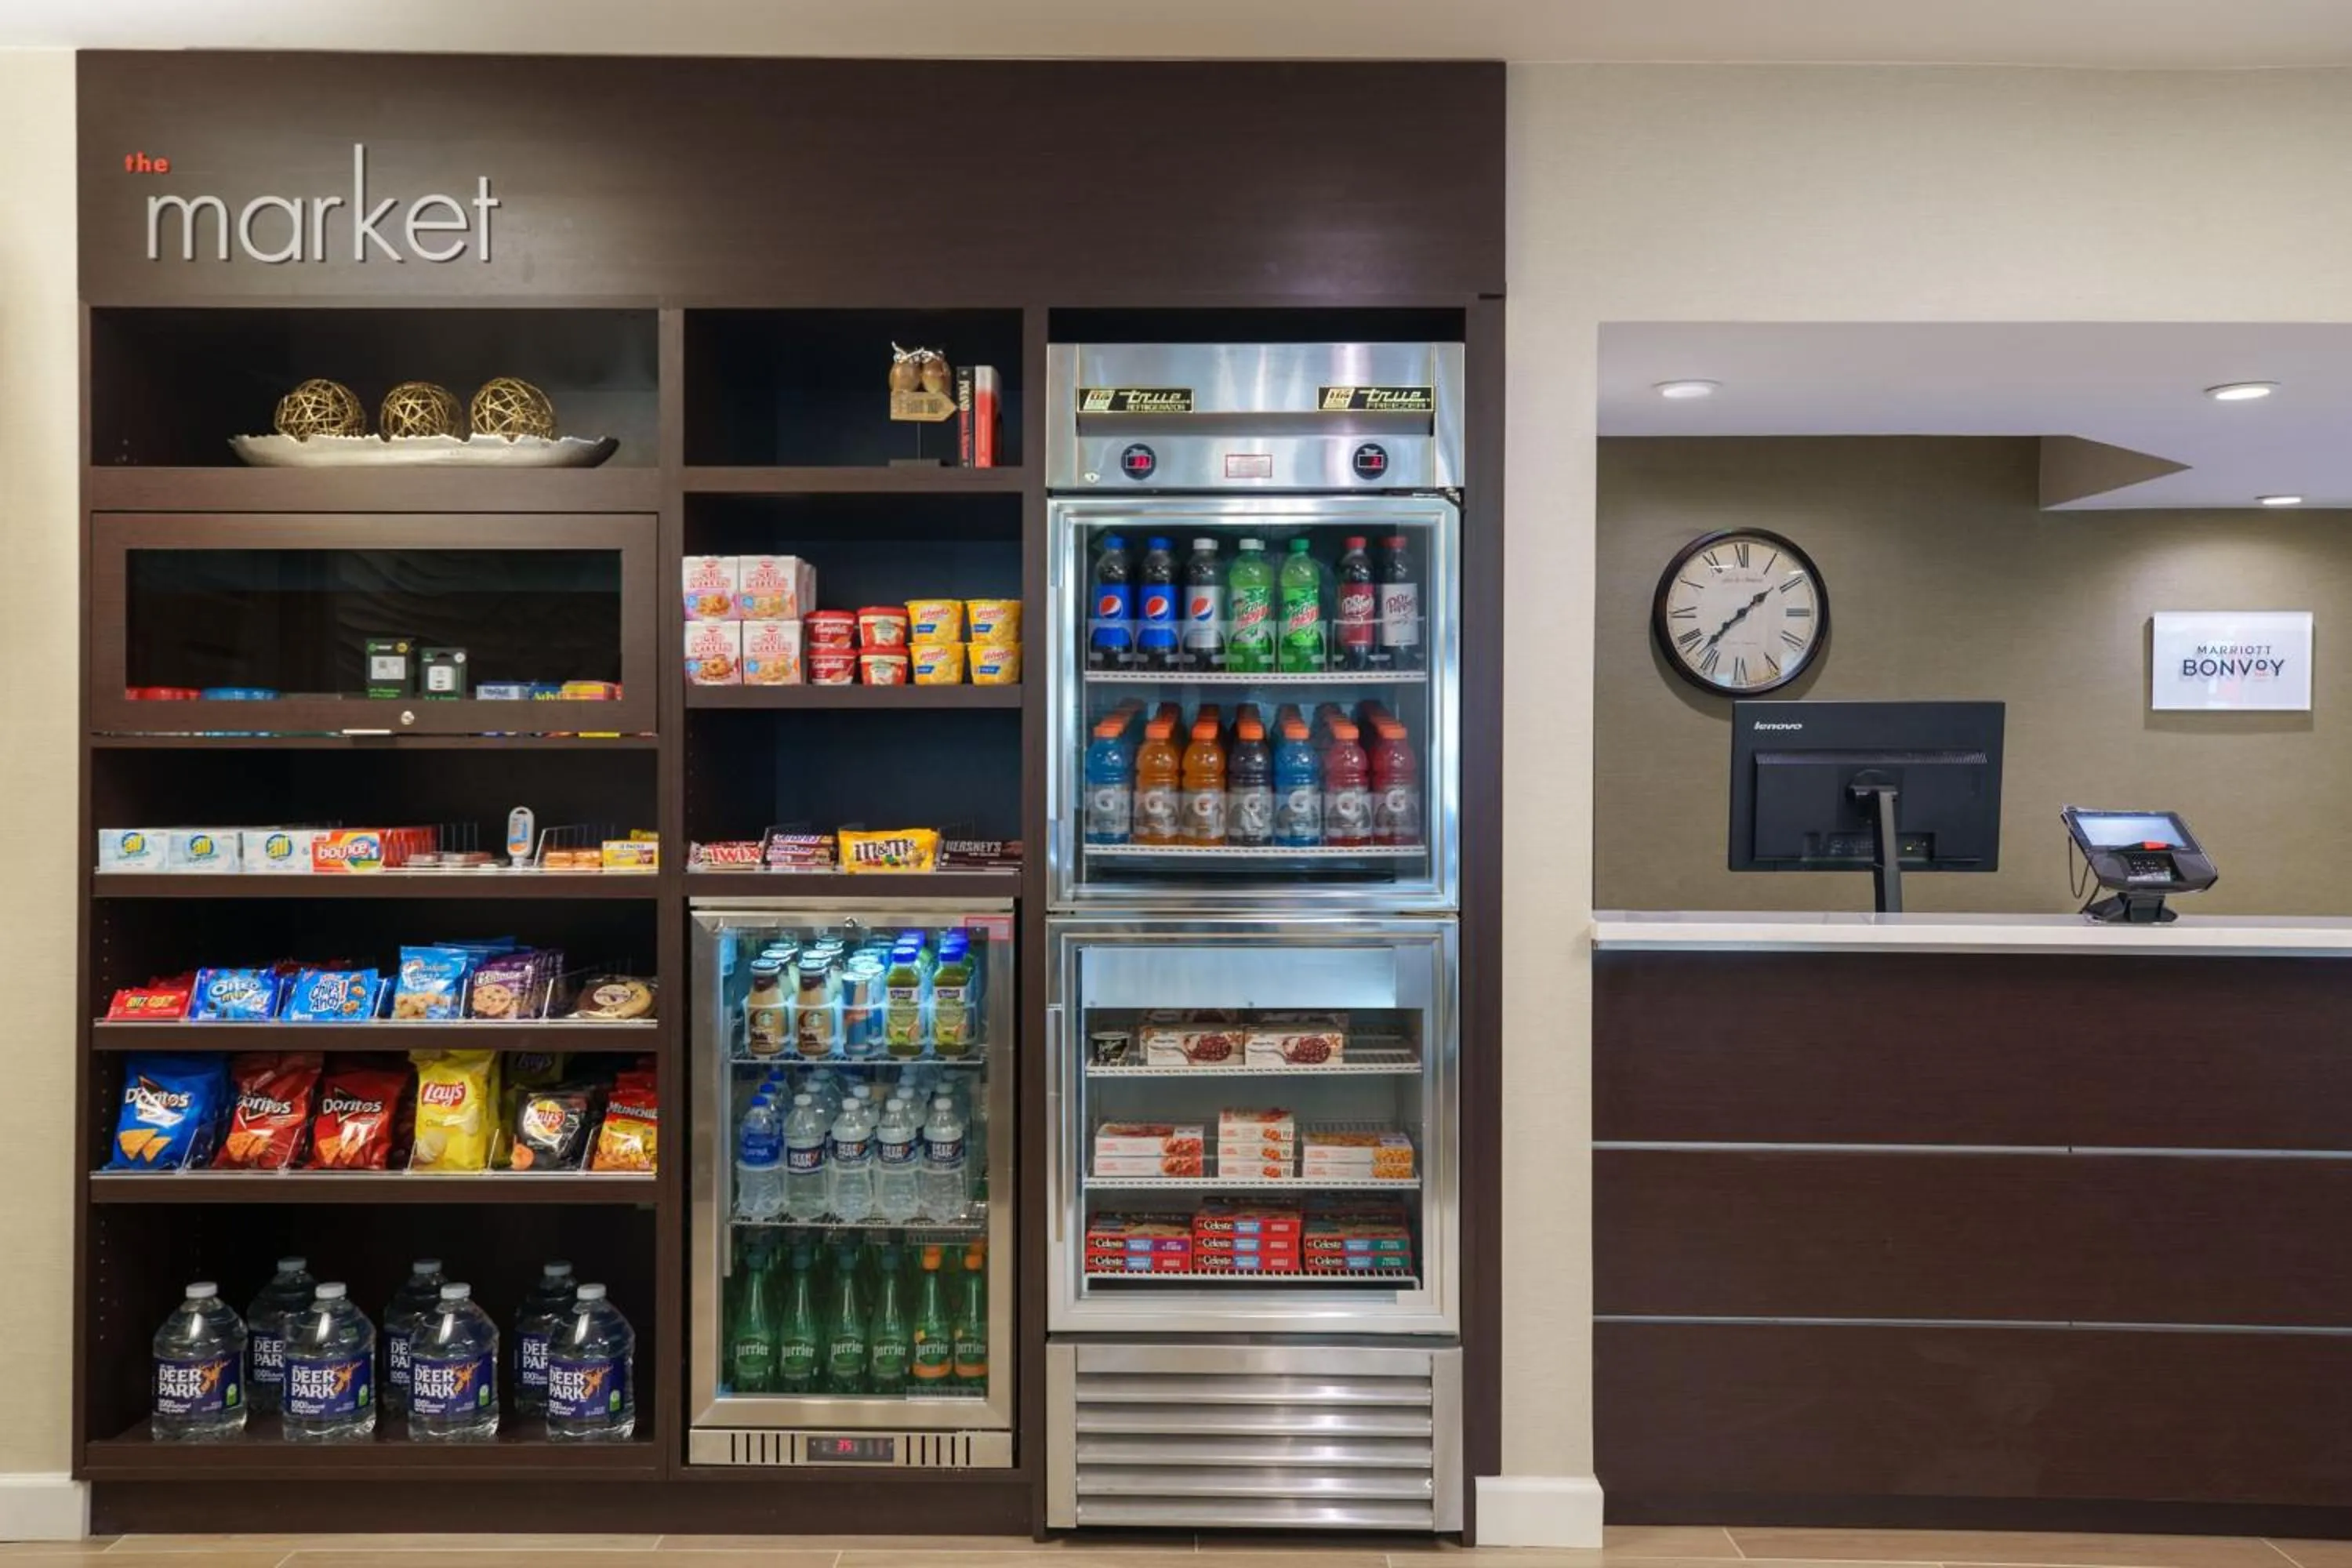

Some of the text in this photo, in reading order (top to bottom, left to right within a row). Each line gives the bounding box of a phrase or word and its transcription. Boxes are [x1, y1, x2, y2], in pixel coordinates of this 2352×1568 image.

[125, 152, 169, 173] the
[147, 143, 501, 263] market
[2197, 645, 2271, 655] MARRIOTT
[1754, 721, 1802, 730] lenovo
[1097, 789, 1116, 811] G
[1145, 792, 1164, 815] G
[1194, 793, 1214, 816] G
[1243, 793, 1261, 813] G
[1289, 789, 1310, 814] G
[1337, 791, 1362, 818] G
[1386, 789, 1406, 812] G
[193, 837, 212, 854] all
[322, 1098, 383, 1114] Doritos
[253, 1340, 285, 1352] DEE
[390, 1341, 411, 1355] DE
[523, 1341, 548, 1356] DEE
[253, 1352, 285, 1367] PAR
[390, 1355, 411, 1368] PA
[523, 1356, 549, 1370] PAR
[159, 1368, 201, 1382] DEER
[291, 1369, 336, 1384] DEER
[415, 1368, 456, 1382] DEER
[550, 1370, 585, 1386] DEER
[159, 1382, 204, 1399] PARK
[291, 1383, 336, 1399] PARK
[415, 1382, 457, 1399] PARK
[550, 1384, 587, 1403] PARK
